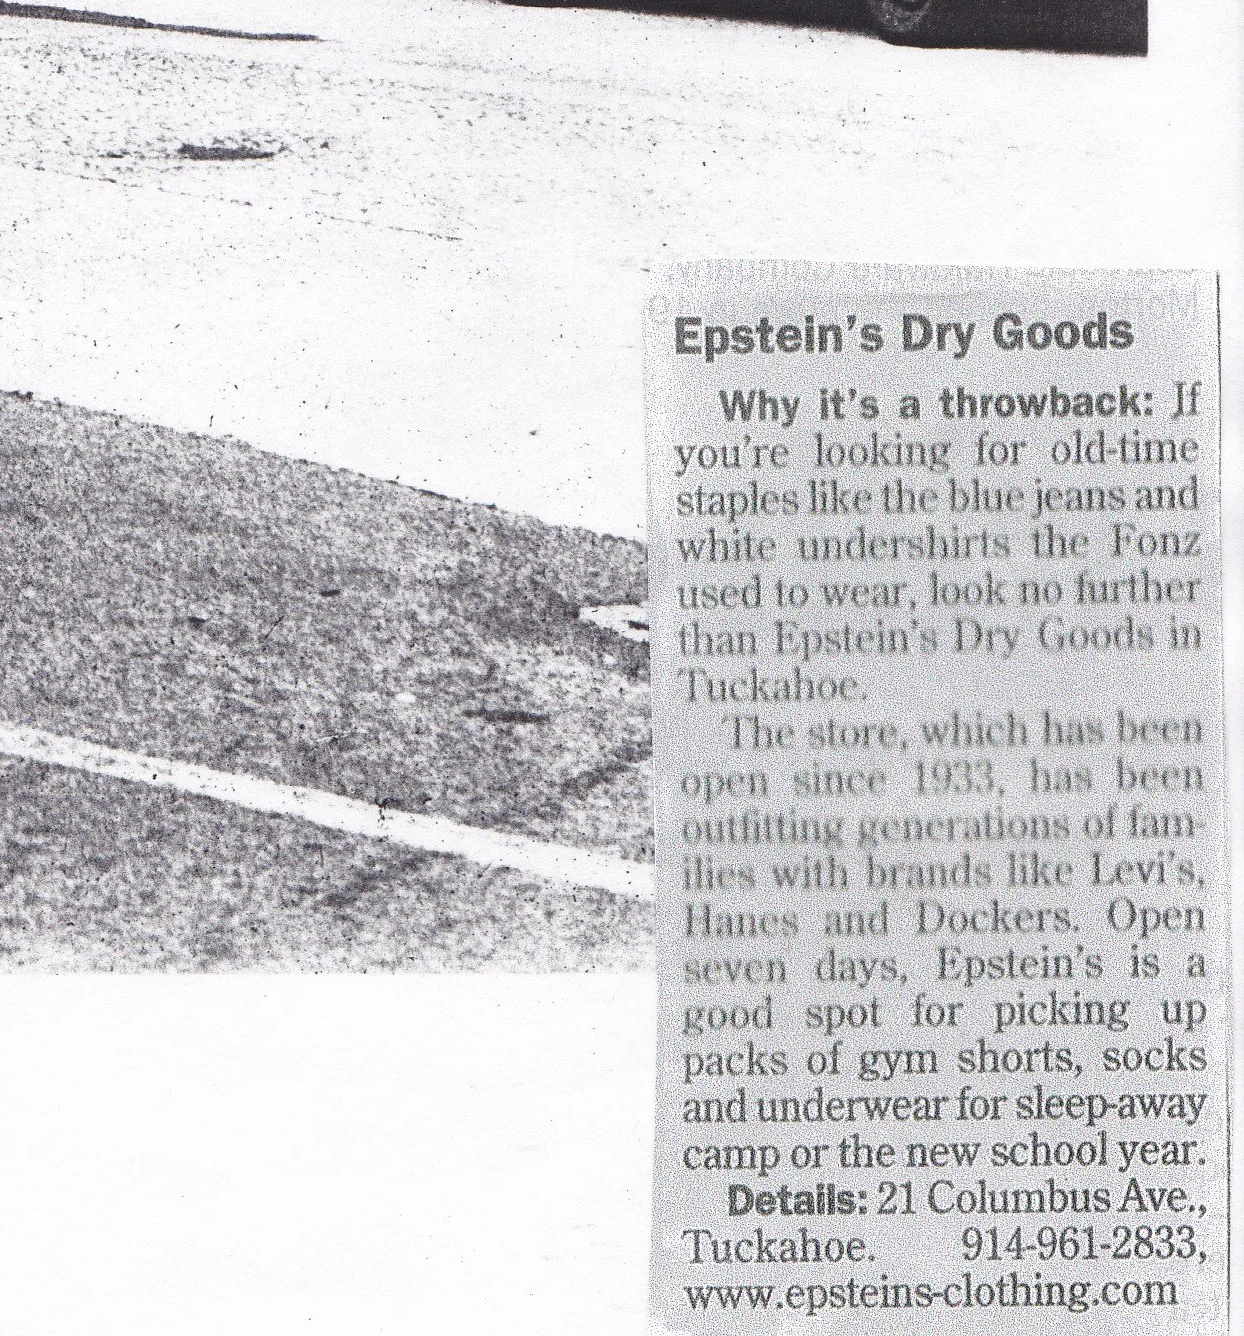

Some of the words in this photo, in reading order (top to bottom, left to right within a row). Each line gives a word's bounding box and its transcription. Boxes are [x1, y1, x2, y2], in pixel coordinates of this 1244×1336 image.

[674, 313, 885, 364] Epstein's
[901, 313, 976, 361] Dry
[992, 310, 1136, 352] Goods
[718, 388, 801, 429] Why
[819, 387, 880, 421] it's
[898, 394, 921, 421] a
[938, 383, 1154, 420] throwback:
[1170, 379, 1203, 422] If
[673, 434, 790, 478] you're
[814, 431, 952, 472] looking
[975, 430, 1027, 467] for
[1050, 428, 1199, 465] old-time
[676, 479, 800, 524] staples
[808, 478, 873, 515] like
[881, 478, 939, 514] the
[948, 477, 1025, 513] blue
[1031, 477, 1127, 520] jeans
[1134, 473, 1200, 512] and
[676, 526, 777, 563] white
[797, 524, 1011, 562] undershirts
[1031, 522, 1089, 559] the
[1112, 522, 1202, 558] Fonz
[677, 573, 762, 610] used
[774, 579, 810, 608] to
[820, 582, 917, 611] wear,
[929, 570, 1006, 607] look
[1019, 580, 1064, 606] no
[1075, 568, 1202, 605] further
[677, 620, 758, 657] than
[774, 618, 939, 663] Epstein's
[953, 616, 1020, 660] Dry
[1037, 614, 1155, 652] Goods
[1169, 615, 1202, 651] in
[676, 666, 870, 704] Tuckahoe.
[721, 714, 795, 751] The
[807, 719, 909, 752] store,
[920, 710, 1029, 748] which
[1041, 709, 1105, 747] has
[1116, 708, 1204, 745] been
[679, 772, 769, 806] open
[793, 762, 886, 796] since
[915, 760, 1005, 796] 1933,
[1029, 757, 1093, 793] has
[1115, 756, 1204, 791] been
[681, 808, 844, 848] outfitting
[857, 807, 1071, 848] generations
[1082, 805, 1116, 839] of
[1128, 804, 1206, 839] fam-
[683, 855, 756, 891] ilies
[771, 854, 849, 890] with
[866, 852, 992, 889] brands
[1007, 851, 1074, 888] like
[1090, 850, 1205, 890] Levi's,
[684, 902, 799, 939] Hanes
[823, 900, 889, 937] and
[916, 898, 1080, 936] Dockers.
[1106, 897, 1205, 941] Open
[683, 959, 787, 984] seven
[814, 947, 908, 990] days,
[937, 943, 1104, 988] Epstein's
[1130, 942, 1161, 979] is
[1186, 953, 1208, 979] a
[681, 994, 774, 1037] good
[805, 997, 881, 1037] spot
[912, 991, 964, 1028] for
[994, 990, 1131, 1035] picking
[1160, 999, 1208, 1033] up
[682, 1040, 789, 1085] packs
[805, 1039, 843, 1076] of
[857, 1049, 939, 1083] gym
[957, 1037, 1084, 1078] shorts,
[1102, 1035, 1208, 1072] socks
[682, 1087, 747, 1124] and
[756, 1085, 950, 1123] underwear
[956, 1084, 1008, 1122] for
[1015, 1083, 1208, 1128] sleep-away
[682, 1144, 782, 1178] camp
[789, 1144, 830, 1169] or
[838, 1132, 896, 1169] the
[906, 1142, 982, 1169] new
[991, 1130, 1108, 1168] school
[1117, 1140, 1207, 1174] year.
[727, 1182, 868, 1218] Details:
[876, 1180, 916, 1216] 21
[926, 1177, 1112, 1216] Columbus
[1117, 1177, 1207, 1218] Ave.,
[681, 1227, 876, 1265] Tuckahoe.
[960, 1223, 1208, 1265] 914-961-2833,
[683, 1271, 1180, 1317] www.epsteins-clothing.com
